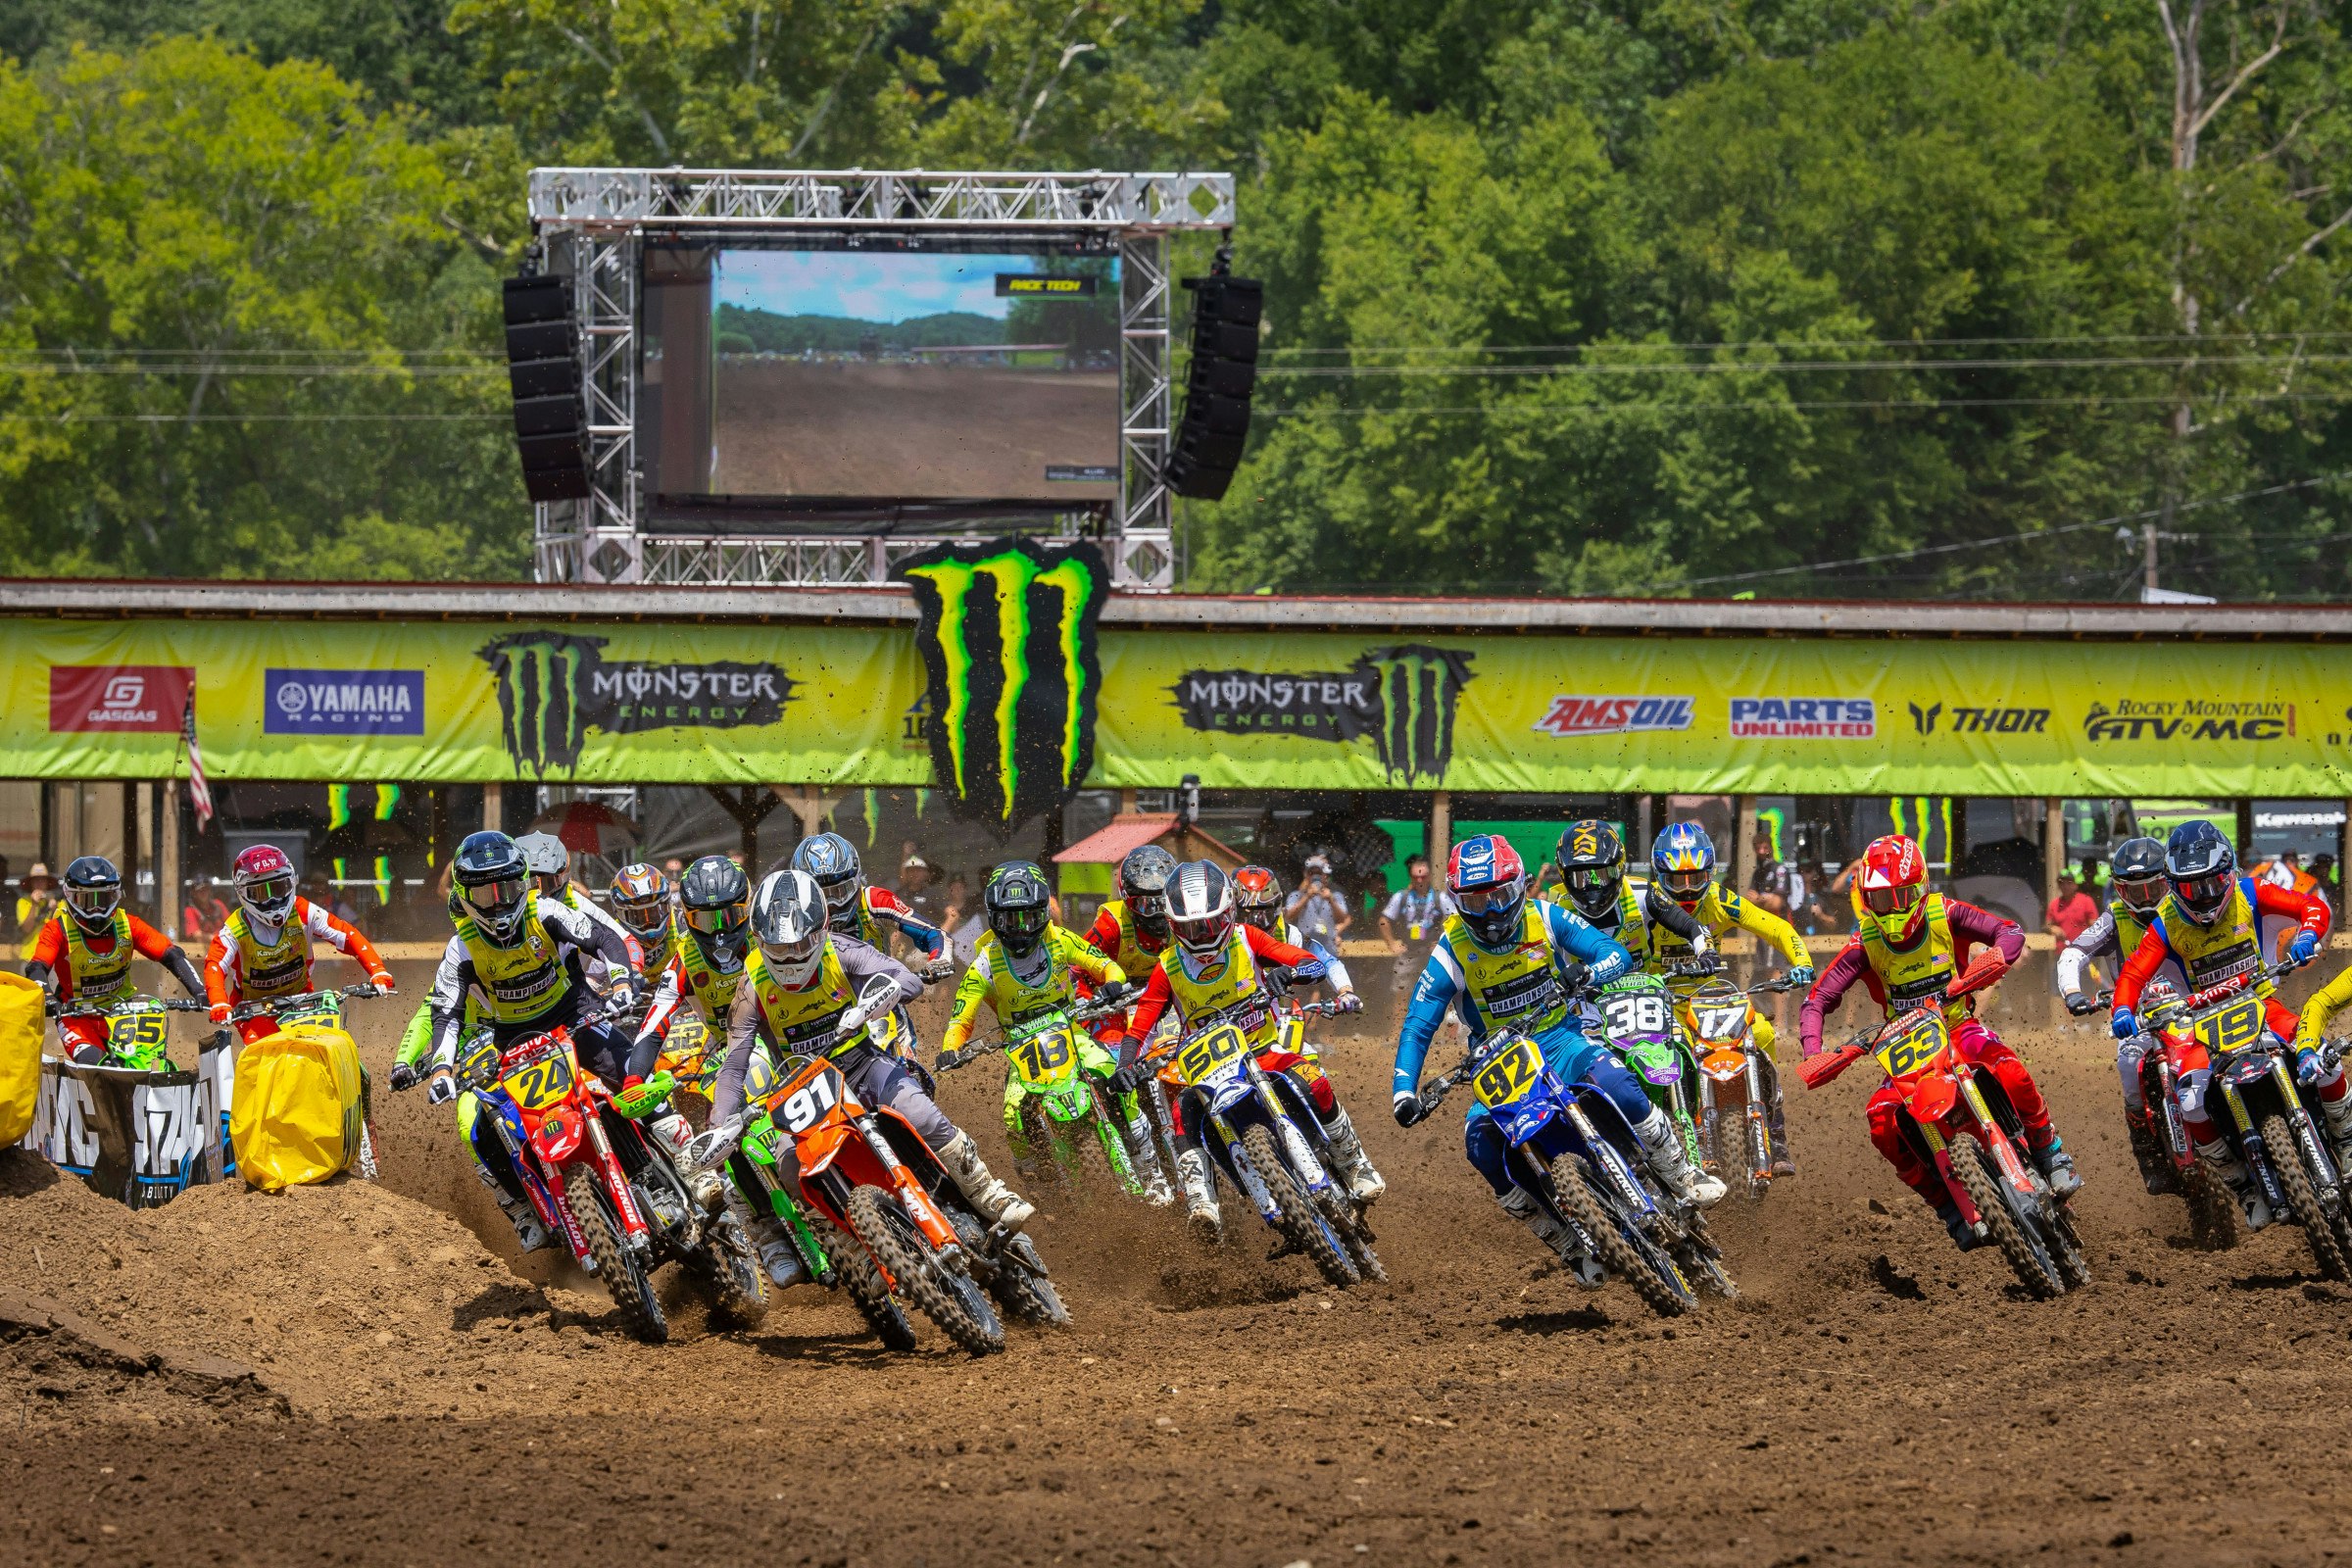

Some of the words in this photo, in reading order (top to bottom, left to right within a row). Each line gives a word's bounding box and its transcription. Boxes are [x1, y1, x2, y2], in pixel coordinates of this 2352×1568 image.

[309, 684, 412, 713] YAMAHA
[592, 666, 780, 702] MONSTER
[1189, 676, 1369, 710] MONSTER
[87, 710, 158, 723] GASGAS
[288, 713, 404, 723] RACING
[618, 705, 749, 720] ENERGY
[1214, 713, 1340, 727] ENERGY
[1542, 697, 1694, 732] AMSOIL
[1731, 699, 1874, 721] PARTS
[1951, 708, 2051, 734] THOR
[1731, 722, 1874, 736] UNLIMITED
[2191, 718, 2286, 741] MC
[1466, 865, 1489, 874] YAMAHA
[2303, 906, 2322, 928] FLY
[87, 952, 123, 965] Kawasaki
[256, 941, 293, 957] Kawasaki
[2212, 948, 2238, 959] MONSTER
[714, 974, 742, 990] Kawa
[1507, 973, 1535, 988] MONSTER
[1908, 977, 1936, 989] MONSTER
[2198, 956, 2256, 986] CHAMPIONSHIP
[1017, 978, 1058, 997] Kawasaki
[1491, 980, 1553, 1012] CHAMPIONSHIP
[864, 987, 896, 1018] ACERBIS
[1547, 998, 1560, 1009] ASV
[113, 1016, 164, 1045] 65
[1605, 996, 1665, 1040] 38
[1697, 1006, 1746, 1039] 17
[2201, 1002, 2259, 1052] 19
[793, 1032, 834, 1054] CHAMPIO
[1018, 1033, 1069, 1081] 18
[1183, 1028, 1241, 1084] 50
[1887, 1020, 1943, 1077] 63
[519, 1058, 571, 1107] 24
[1479, 1044, 1541, 1106] 92
[627, 1089, 665, 1111] ACERBIS
[783, 1071, 836, 1134] 91
[1425, 1097, 1439, 1112] ASV
[701, 1138, 730, 1168] ACERBIS
[2302, 1127, 2328, 1176] DUNLOP
[1601, 1154, 1639, 1207] DUNLOP
[609, 1170, 639, 1224] DUNLOP
[901, 1186, 931, 1222] KTM
[557, 1195, 585, 1249] DUNLOP
